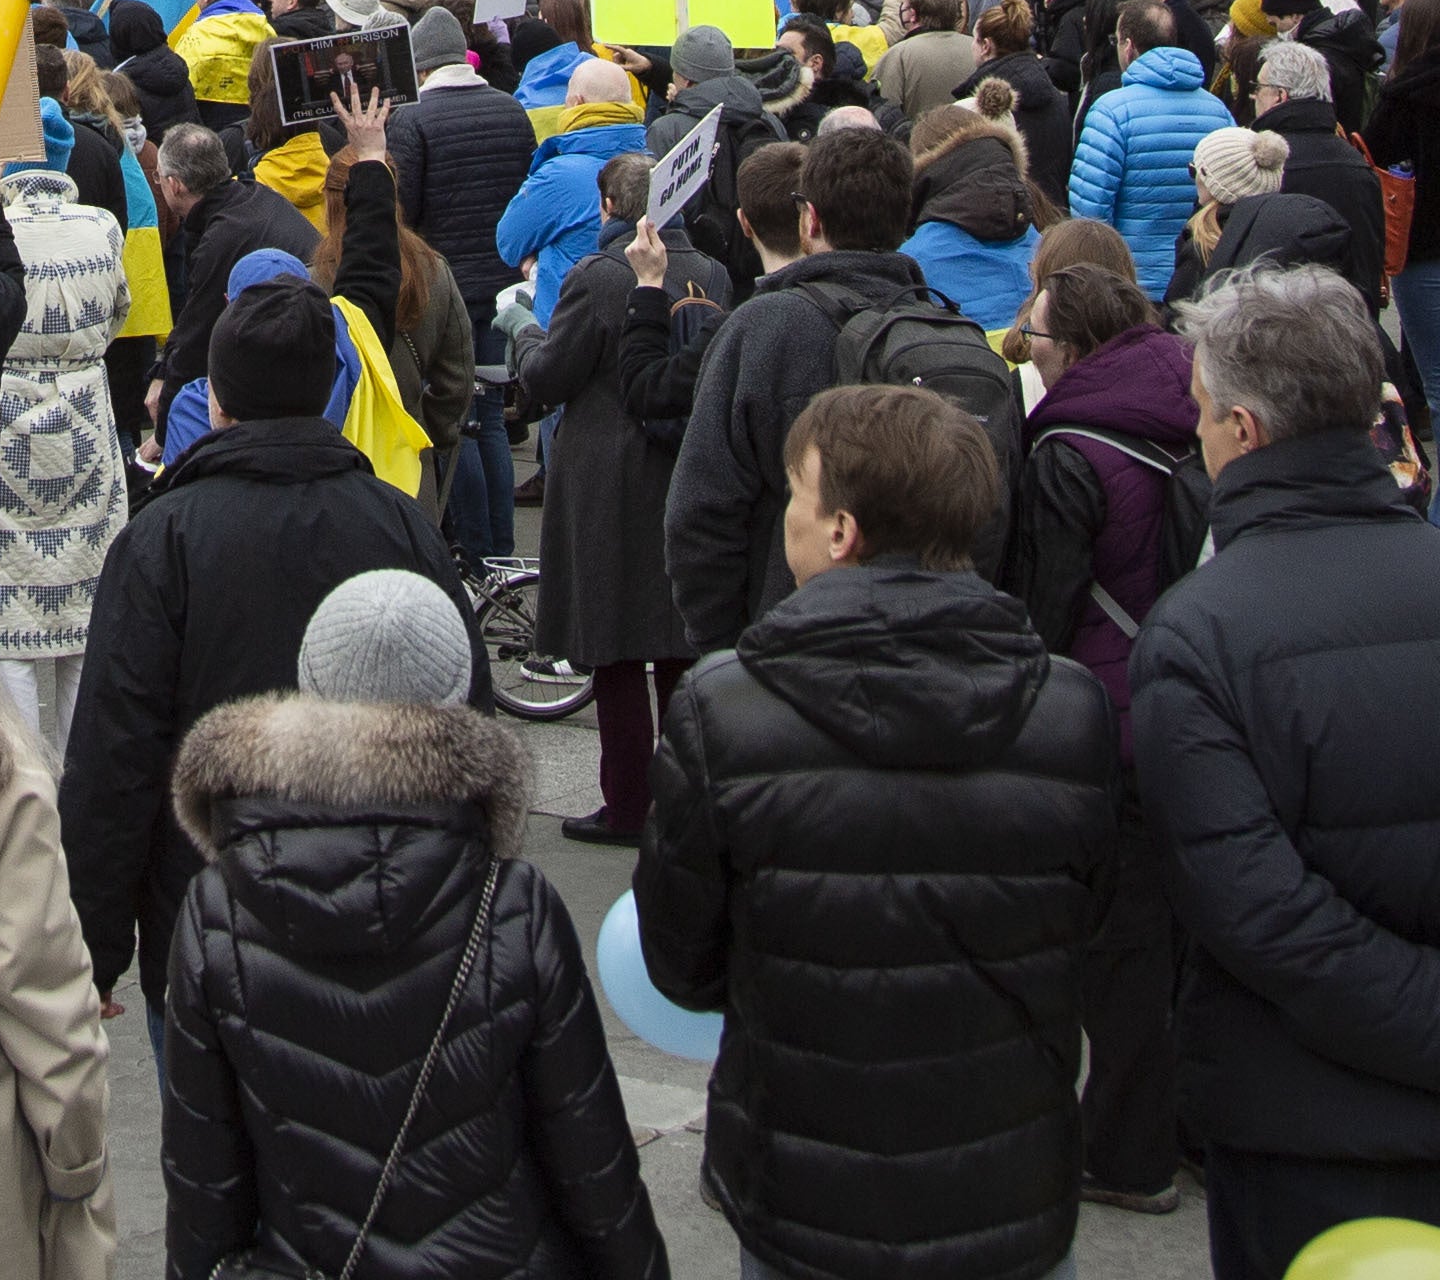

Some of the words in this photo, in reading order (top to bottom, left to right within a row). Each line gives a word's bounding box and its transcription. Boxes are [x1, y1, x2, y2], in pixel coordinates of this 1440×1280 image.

[310, 40, 334, 51] HIM
[351, 29, 399, 44] PRISON
[293, 109, 314, 120] (THE
[315, 106, 334, 116] CLU
[671, 135, 701, 177] PUTIN
[660, 182, 675, 207] GO
[676, 153, 703, 192] HOME
